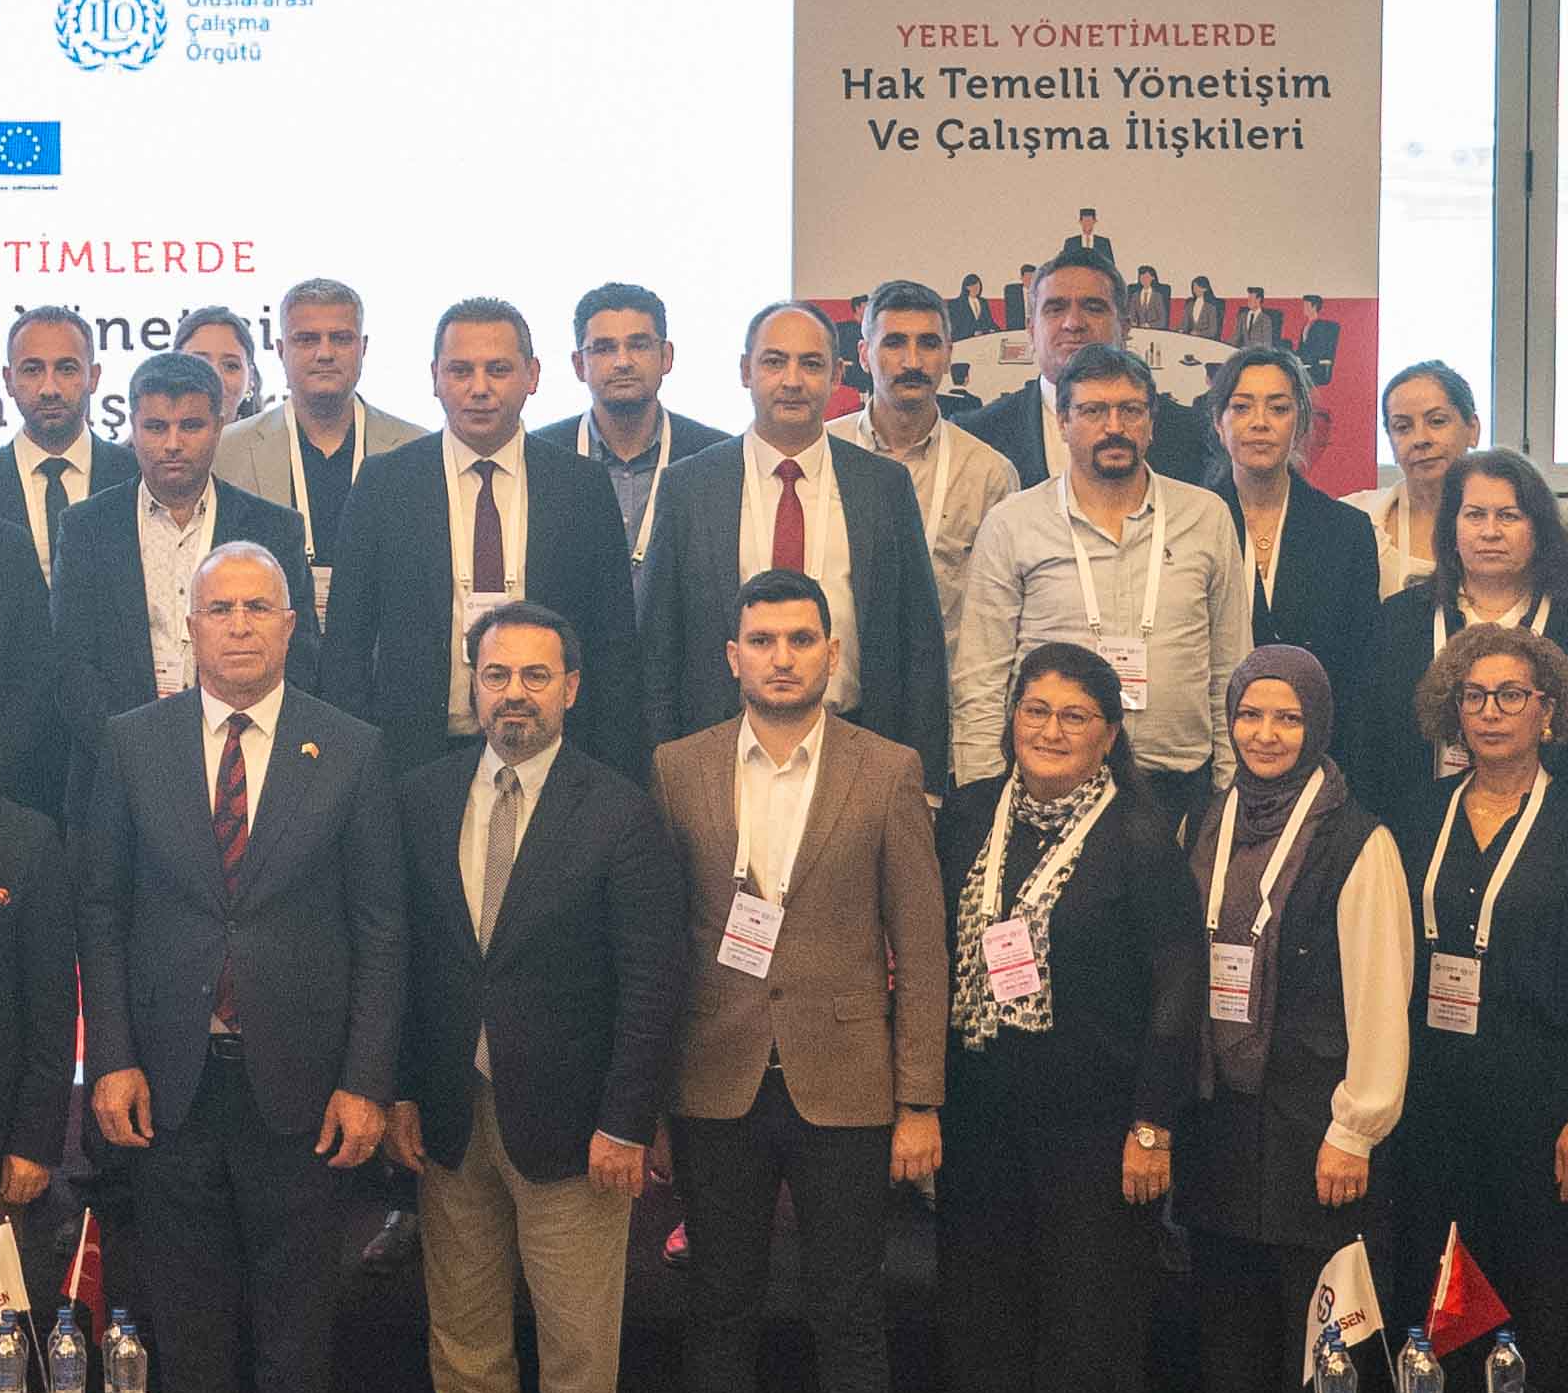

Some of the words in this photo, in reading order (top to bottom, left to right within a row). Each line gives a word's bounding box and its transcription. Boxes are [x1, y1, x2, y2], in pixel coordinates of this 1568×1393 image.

[186, 13, 270, 38] Çalışma
[897, 24, 999, 48] YEREL
[1011, 18, 1276, 48] YÖNETİMLERDE
[186, 38, 262, 64] Örgütü
[841, 67, 925, 100] Hak
[938, 67, 1100, 100] Temelli
[1113, 66, 1332, 107] Yönetişim
[867, 119, 920, 151] Ve
[936, 118, 1110, 159] Çalışma
[1125, 110, 1304, 159] İlişkileri
